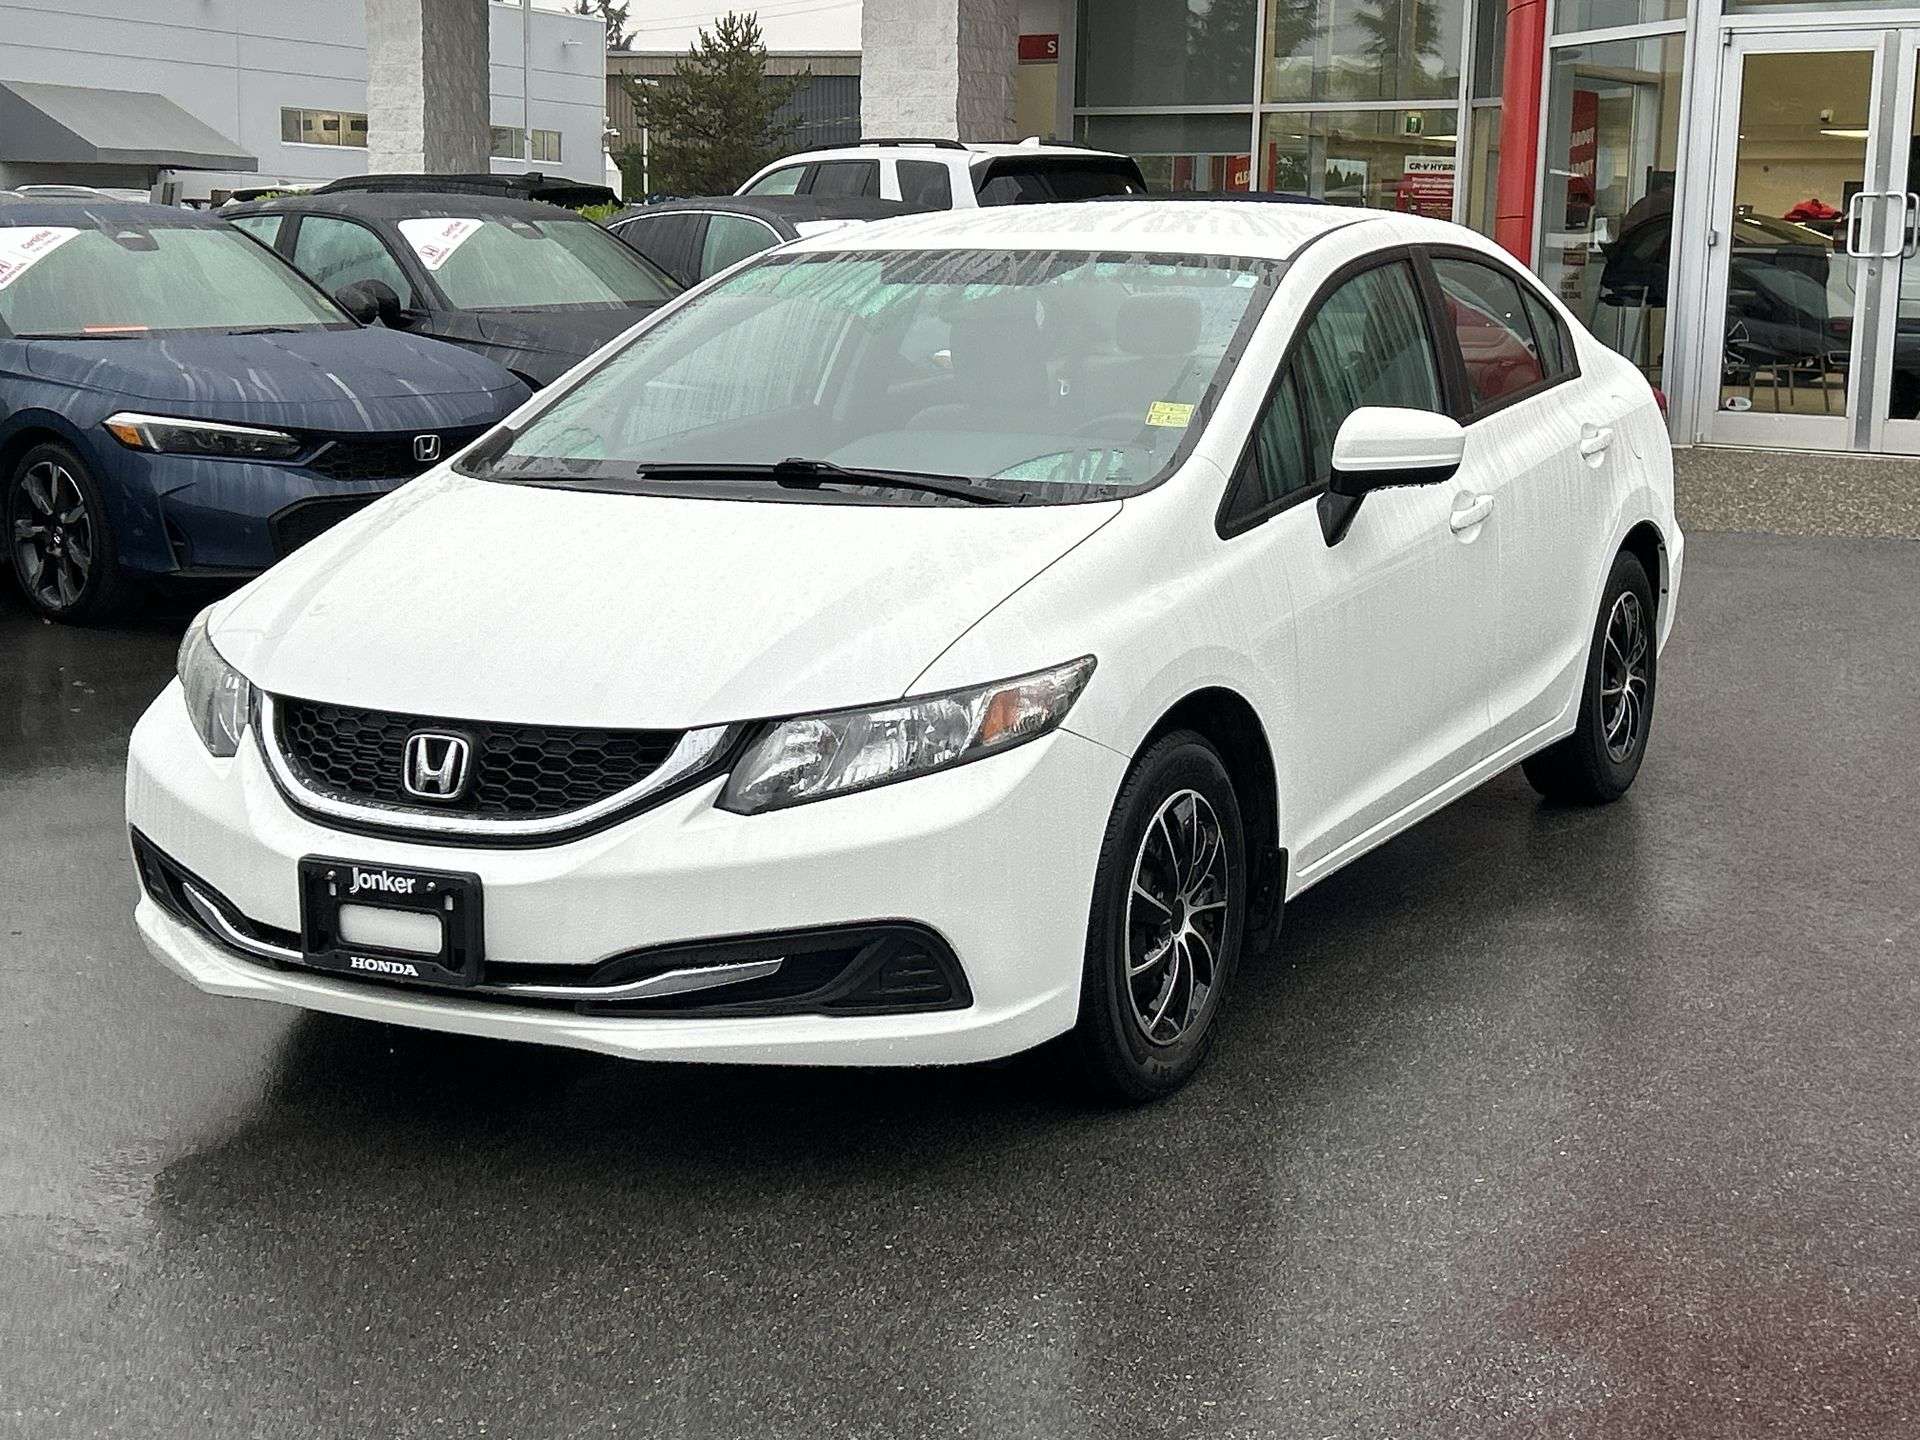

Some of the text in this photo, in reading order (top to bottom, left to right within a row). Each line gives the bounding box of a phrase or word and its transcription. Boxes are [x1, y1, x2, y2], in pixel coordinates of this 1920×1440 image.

[1409, 162, 1430, 171] CR-V
[349, 866, 416, 894] Jonker
[350, 956, 419, 977] HONDA
